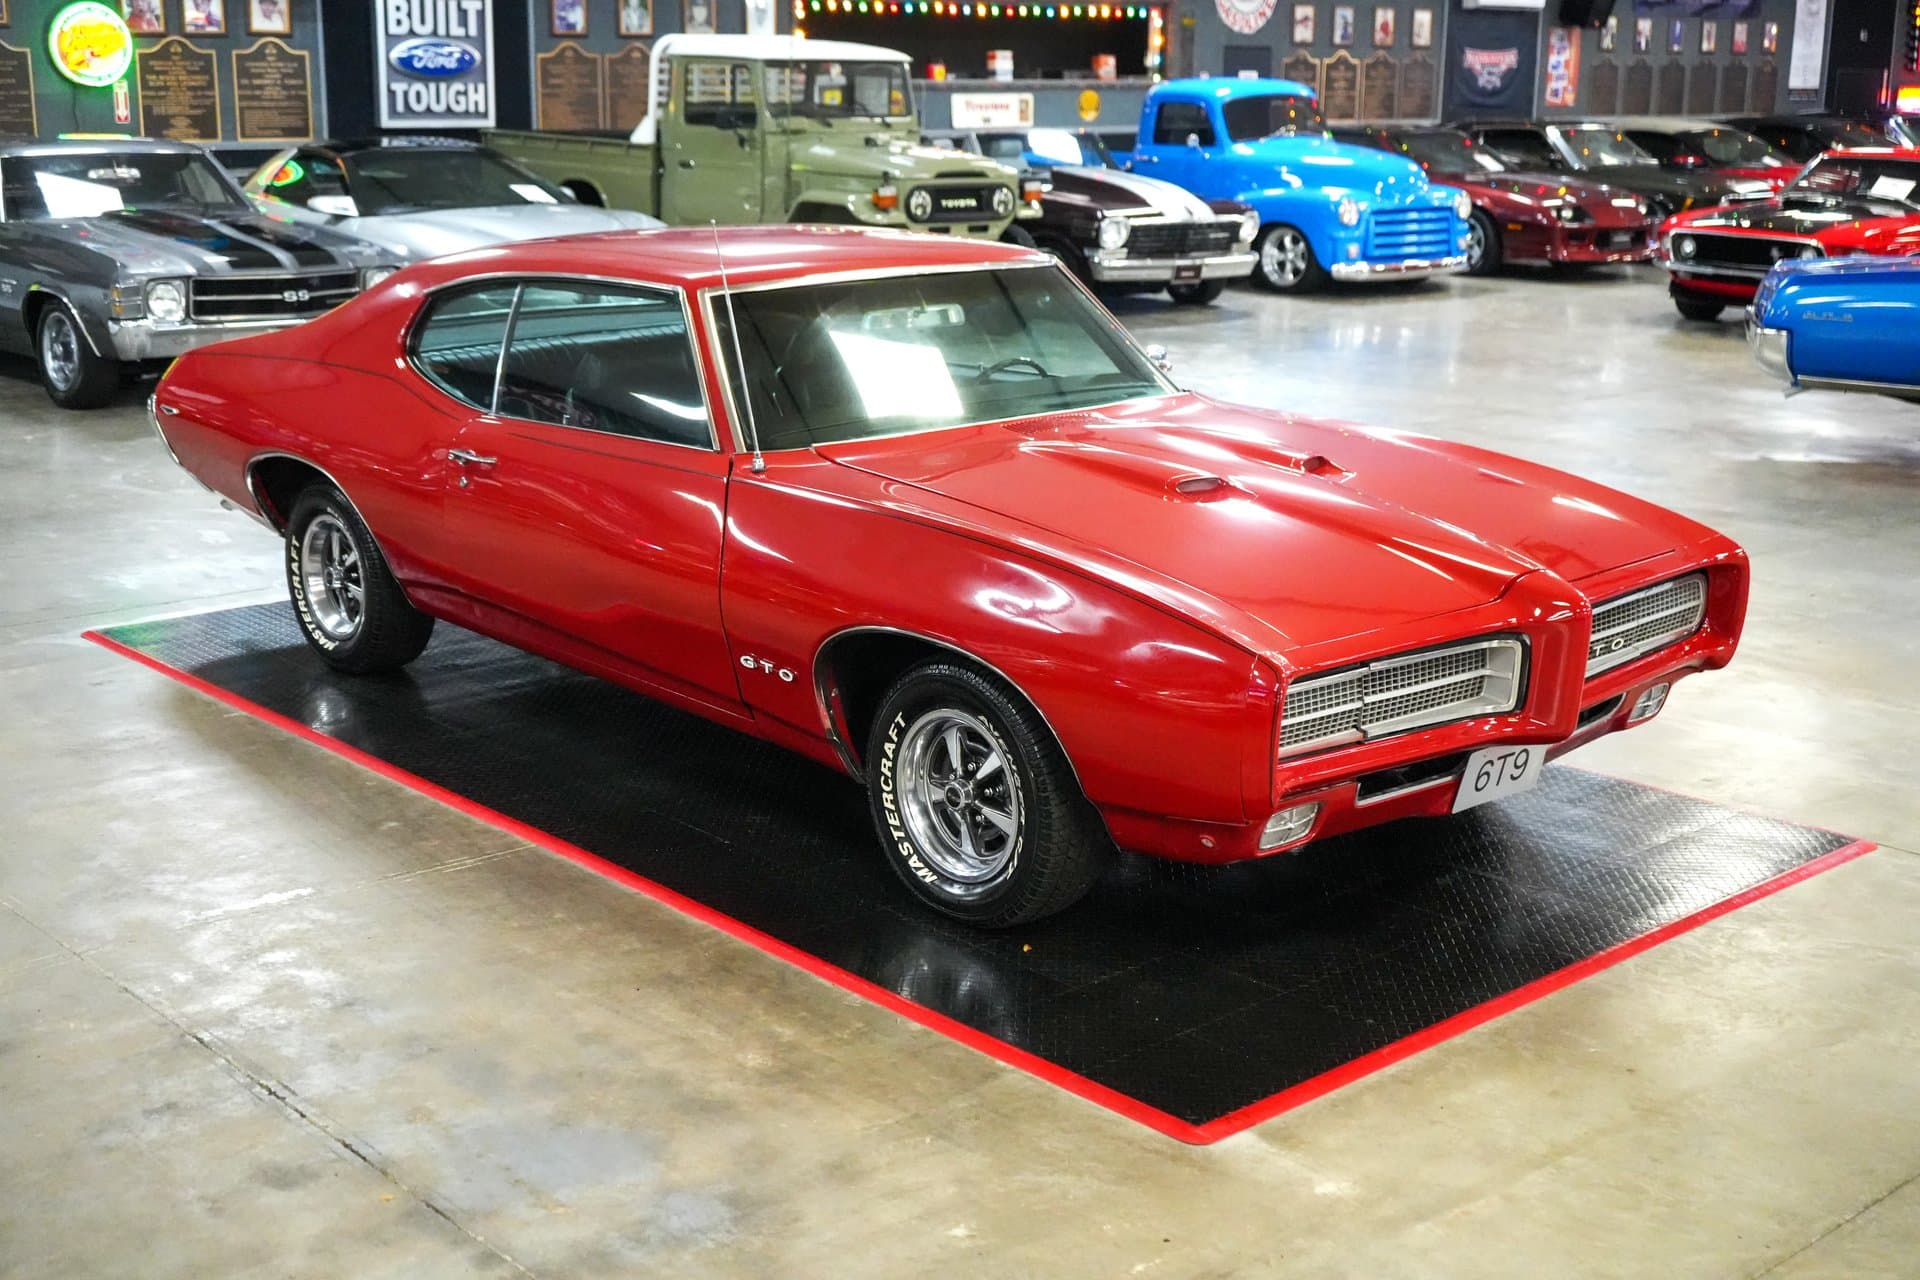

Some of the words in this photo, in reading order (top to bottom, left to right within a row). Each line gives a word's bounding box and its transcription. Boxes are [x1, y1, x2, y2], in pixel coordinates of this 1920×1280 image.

[387, 0, 483, 37] BUILT
[389, 82, 486, 113] TOUGH
[941, 198, 978, 208] TOYOTA
[283, 289, 310, 302] SS
[290, 535, 339, 651] MASTERCRAFT
[1592, 638, 1624, 657] TO
[740, 655, 794, 682] GTO
[1474, 748, 1530, 792] 6T9
[880, 711, 939, 885] MASTERCRAFT
